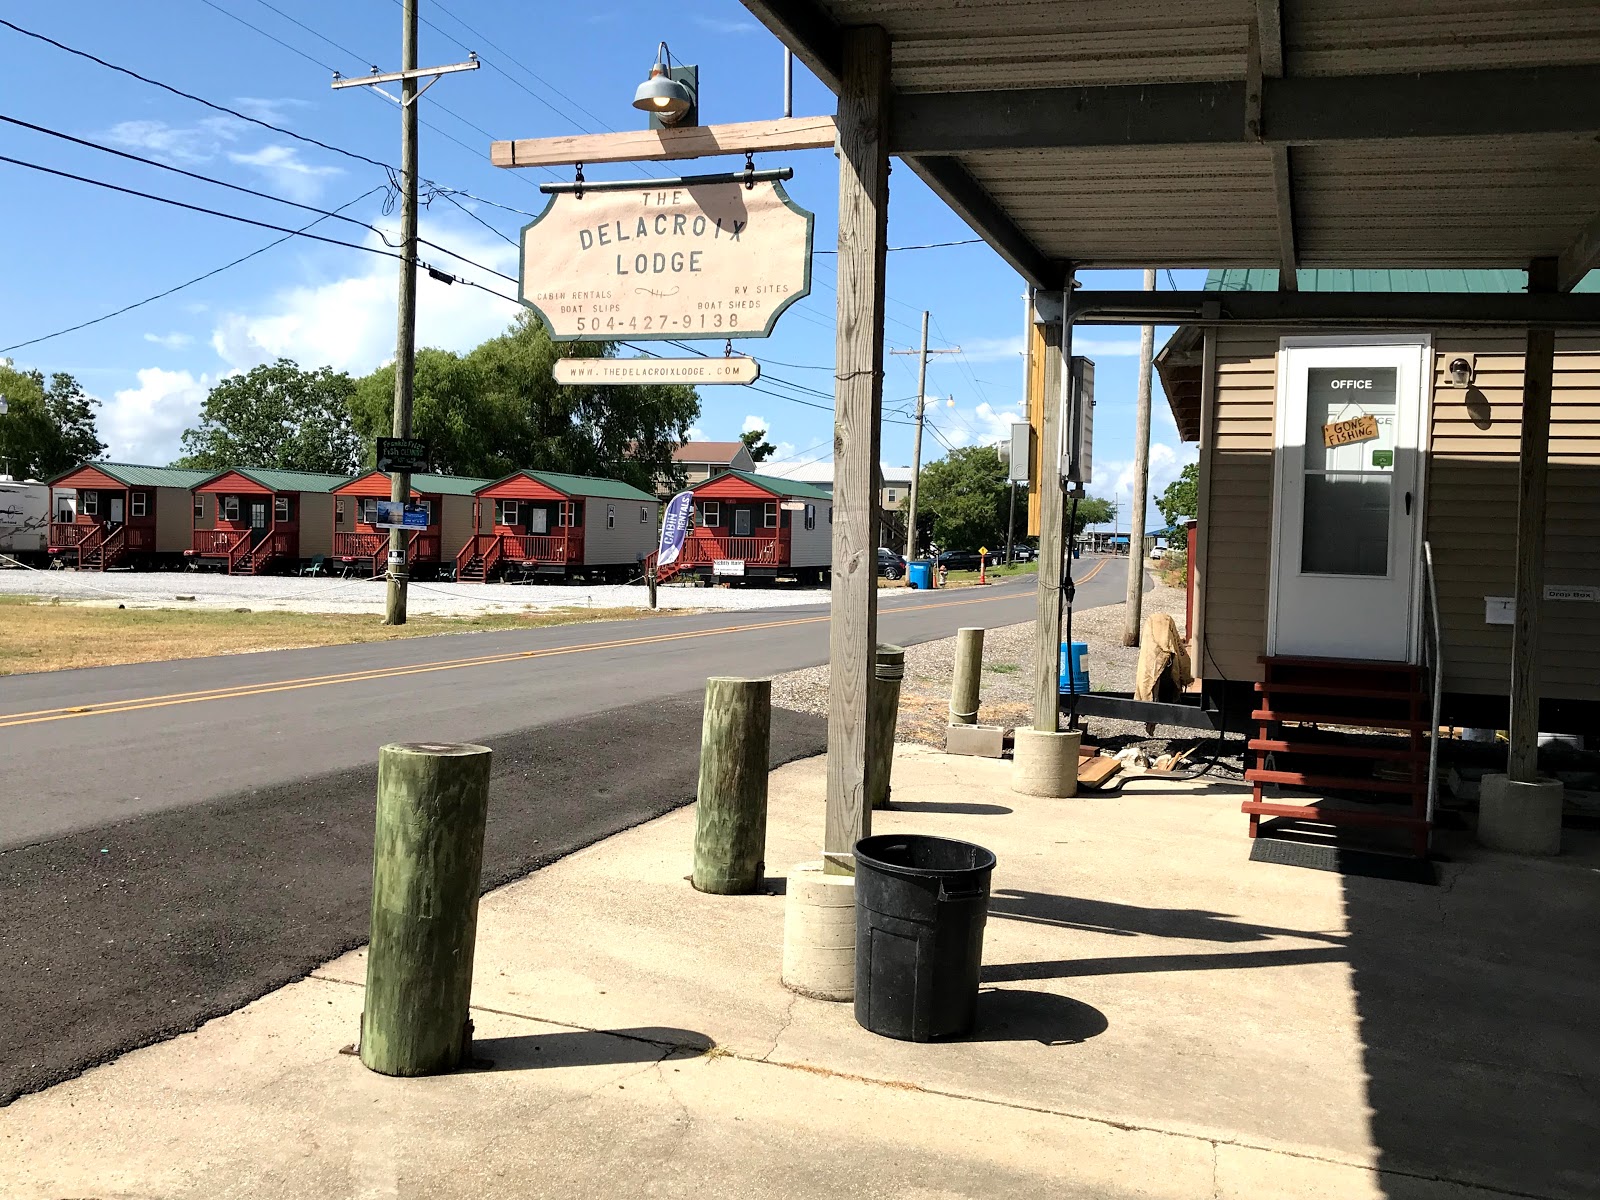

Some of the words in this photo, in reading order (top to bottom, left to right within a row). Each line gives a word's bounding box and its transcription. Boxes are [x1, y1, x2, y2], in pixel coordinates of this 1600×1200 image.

[643, 191, 682, 206] THE
[580, 214, 746, 250] DELACROIX
[617, 251, 703, 275] LODGE
[537, 292, 566, 301] CABIN
[572, 290, 612, 300] RENTALS
[734, 286, 748, 294] RV
[756, 284, 789, 294] SITES
[560, 305, 583, 313] BOAT
[592, 304, 620, 313] SLIPS
[697, 301, 722, 309] BOAT
[728, 300, 761, 309] SHEDS
[577, 313, 739, 331] 504-427-9138
[1331, 379, 1373, 389] OFFICE
[1334, 419, 1365, 434] GONE
[1328, 425, 1373, 446] FISHING
[663, 513, 678, 545] CABIN
[677, 497, 690, 531] RENTALS
